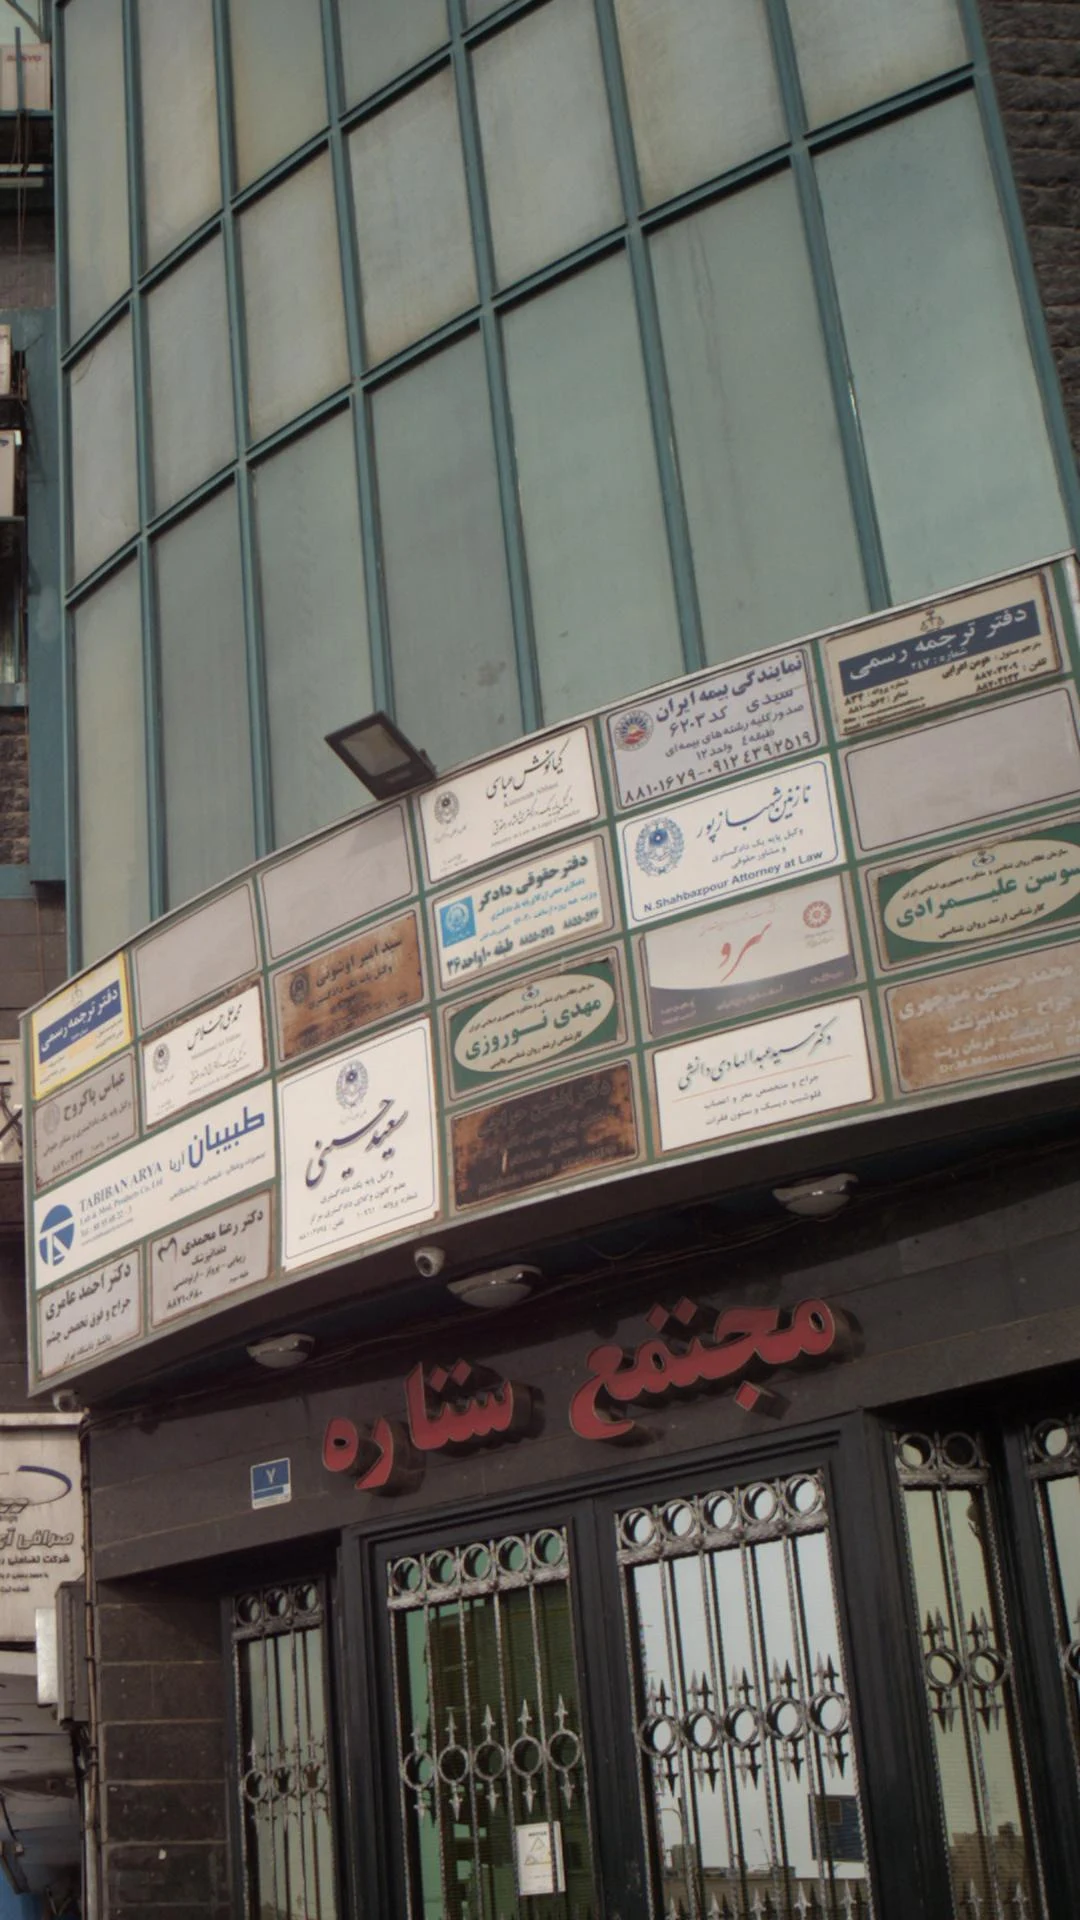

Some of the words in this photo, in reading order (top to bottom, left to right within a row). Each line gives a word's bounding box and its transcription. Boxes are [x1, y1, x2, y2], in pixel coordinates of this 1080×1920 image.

[914, 620, 976, 652] ترجمه
[986, 608, 1028, 638] دفتر
[731, 655, 802, 696] نمایندگی
[849, 648, 908, 680] رسمی
[655, 690, 695, 722] ایران
[699, 684, 728, 702] بیمه
[670, 714, 705, 737] ۶۲۰۳
[708, 705, 728, 723] کد
[750, 711, 772, 727] کلیه
[772, 703, 804, 723] صدور
[709, 742, 733, 755] واحد
[748, 728, 775, 743] طبقه
[561, 854, 588, 879] دفتر
[731, 862, 781, 886] Attorney
[784, 858, 796, 870] at
[798, 850, 824, 866] Law
[516, 867, 559, 895] حقوقی
[494, 935, 513, 957] طبقه
[68, 1000, 96, 1029] ترجمه
[97, 987, 119, 1017] دفتر
[553, 998, 602, 1029] مهدی
[40, 1024, 69, 1053] رسمی
[465, 1009, 549, 1060] نوروزی
[99, 1071, 126, 1102] عباس
[798, 1074, 819, 1087] جراح
[188, 1106, 265, 1169] طبیبان
[305, 1098, 395, 1190] حسینی
[365, 1109, 409, 1161] سعید
[80, 1179, 131, 1213] TABIBAN
[132, 1161, 163, 1184] ARYA
[240, 1209, 264, 1233] دکتر
[181, 1231, 216, 1257] محمدی
[191, 1244, 227, 1266] دندانپزشک
[78, 1272, 105, 1300] احمد
[107, 1262, 132, 1293] دکتر
[46, 1290, 76, 1321] عامری
[89, 1306, 104, 1328] فوق
[111, 1298, 131, 1317] جراح
[63, 1314, 88, 1341] تخصص
[568, 1296, 837, 1441] مجتمع
[322, 1358, 514, 1491] ستاره
[265, 1467, 276, 1485] ۷
[16, 1529, 75, 1550] صرافی
